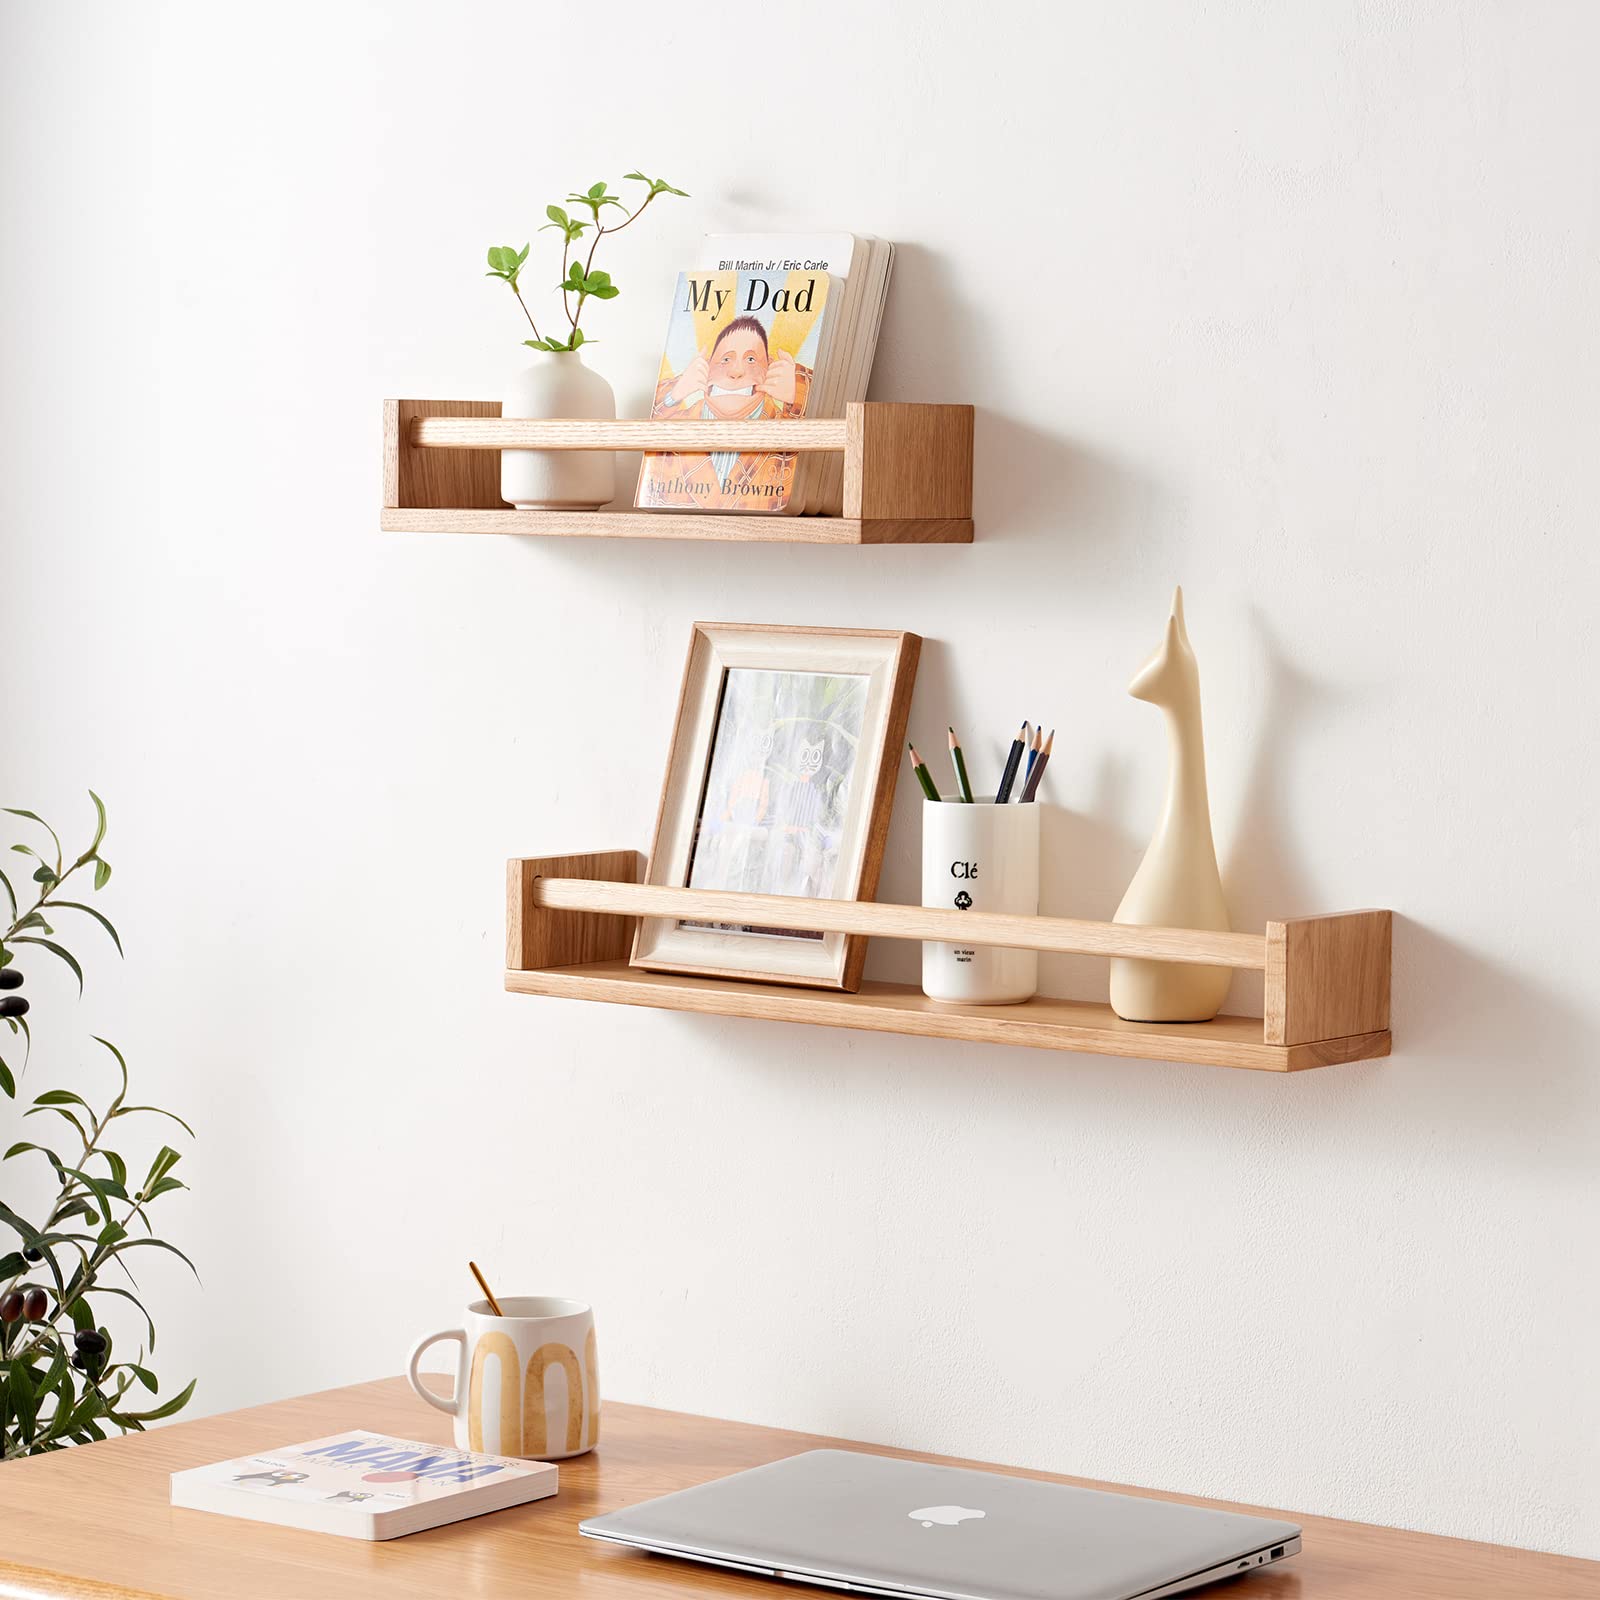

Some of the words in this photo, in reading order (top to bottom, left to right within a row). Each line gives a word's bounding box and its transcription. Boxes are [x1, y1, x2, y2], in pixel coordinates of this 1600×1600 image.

[719, 260, 733, 271] Bill
[735, 260, 764, 271] Martin
[765, 260, 776, 271] Jr
[783, 260, 801, 271] Eric
[803, 260, 829, 271] Carle
[683, 279, 732, 321] My
[743, 278, 816, 313] Dad
[721, 478, 786, 498] Browne
[950, 860, 978, 879] Clé
[301, 1440, 505, 1483] MAMA
